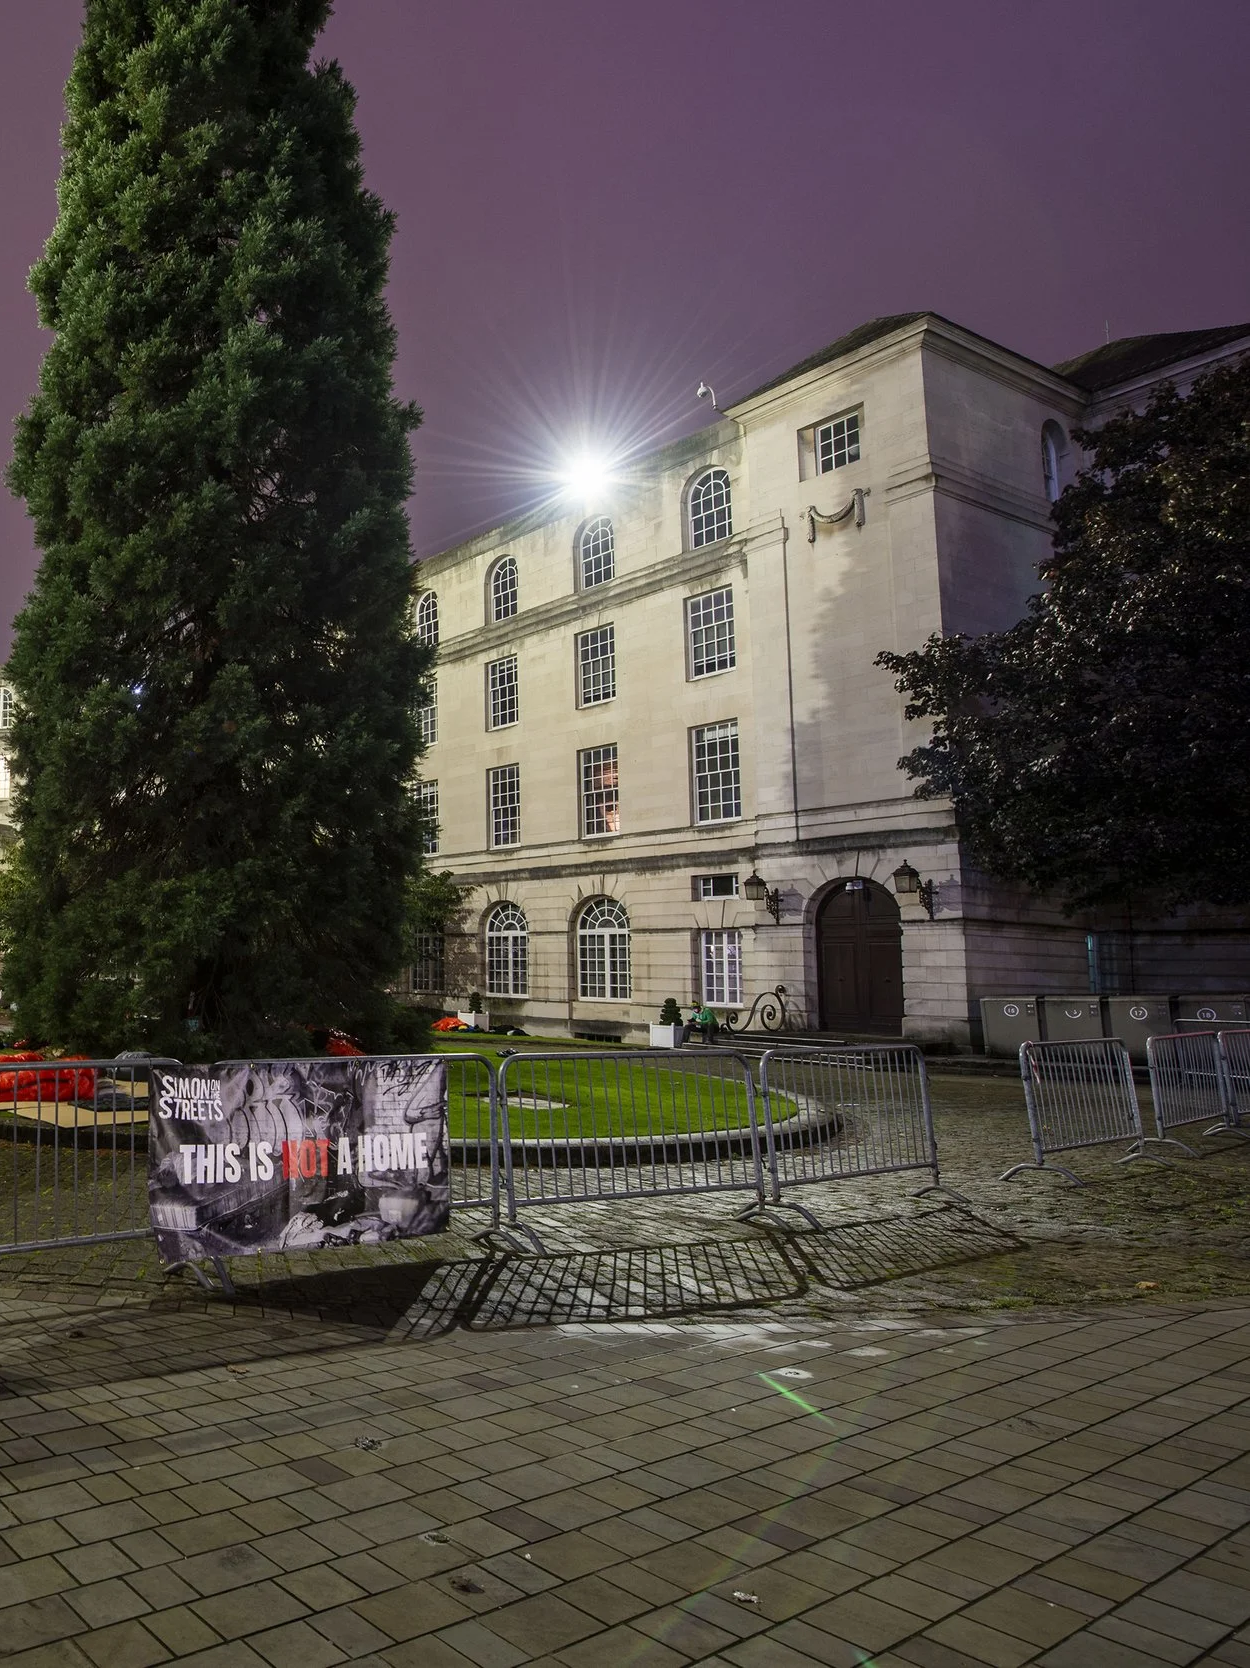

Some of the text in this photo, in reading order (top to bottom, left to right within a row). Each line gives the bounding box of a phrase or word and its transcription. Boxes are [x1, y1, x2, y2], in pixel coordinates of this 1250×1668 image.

[160, 1075, 221, 1100] SIMON ON
[158, 1096, 224, 1122] STREETS
[179, 1132, 430, 1185] THIS IS NOT A HOME
